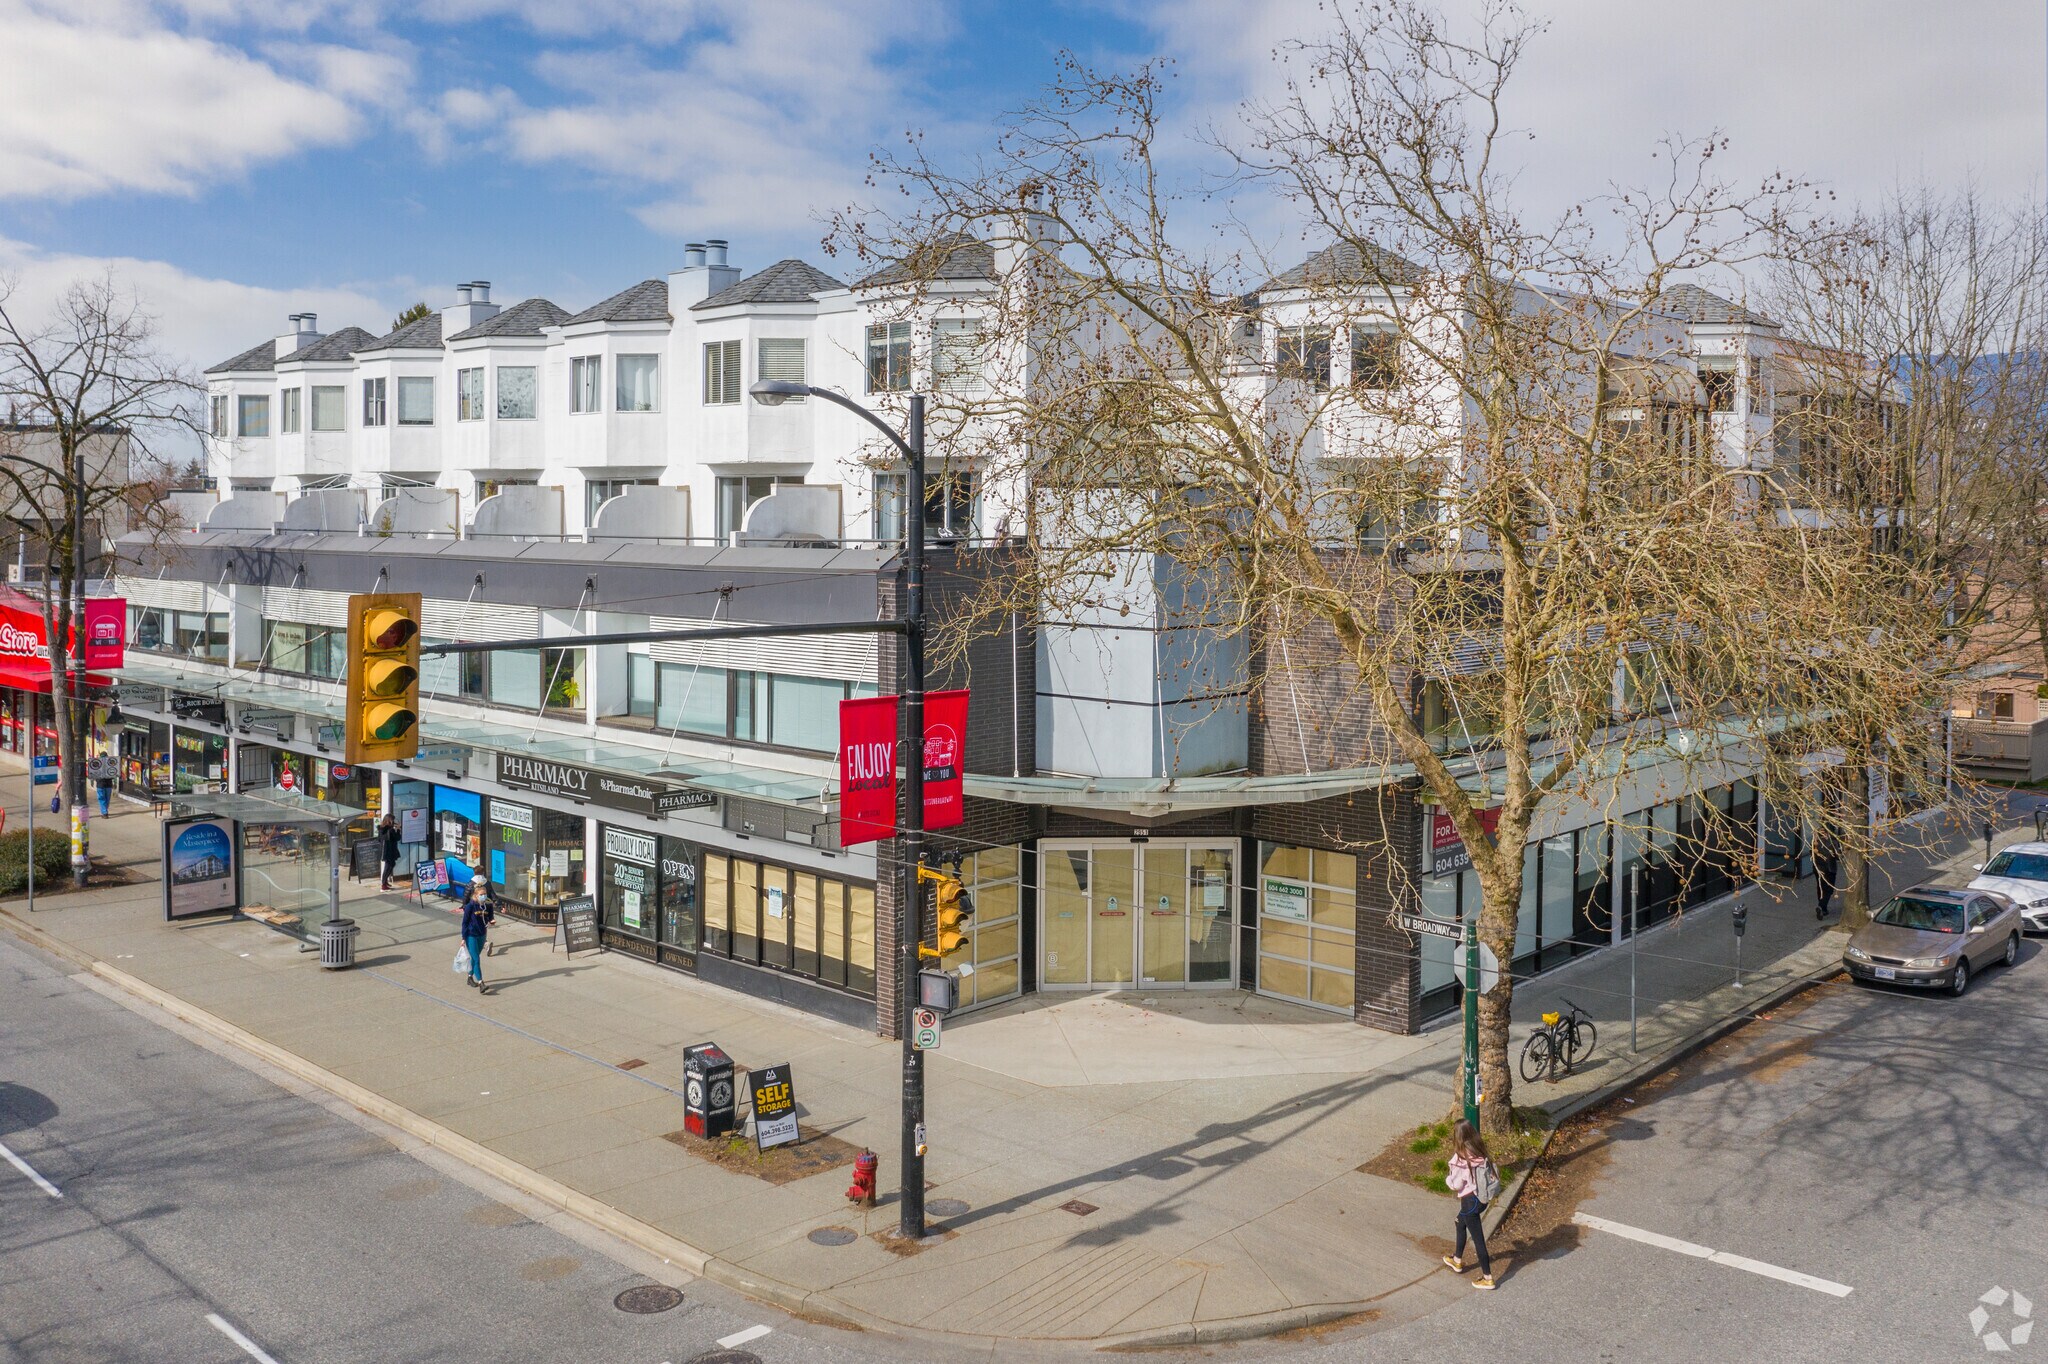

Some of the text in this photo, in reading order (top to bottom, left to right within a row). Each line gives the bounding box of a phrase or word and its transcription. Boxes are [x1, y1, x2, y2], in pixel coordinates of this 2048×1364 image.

[1, 625, 37, 656] Store
[847, 742, 892, 780] ENJOY
[503, 756, 588, 791] PHARMACY
[941, 768, 950, 779] YOU
[530, 782, 559, 795] KITSILANO
[659, 793, 713, 808] PHARMACY
[186, 832, 207, 840] Reside
[1435, 825, 1451, 838] FOR
[183, 838, 220, 848] Masterpiece
[606, 833, 655, 861] PROUDLY LOCAL
[662, 859, 695, 880] OPEN
[1435, 857, 1452, 873] 604
[1454, 853, 1469, 867] 639
[614, 878, 644, 892] EVERYDAY
[1267, 884, 1303, 896] 604 662 3000
[563, 902, 593, 912] PHARMACY
[1404, 917, 1411, 928] W
[1412, 919, 1451, 937] BROADWAY
[665, 951, 693, 968] OWNED
[756, 1083, 789, 1105] SELF
[757, 1099, 791, 1114] STORAGE
